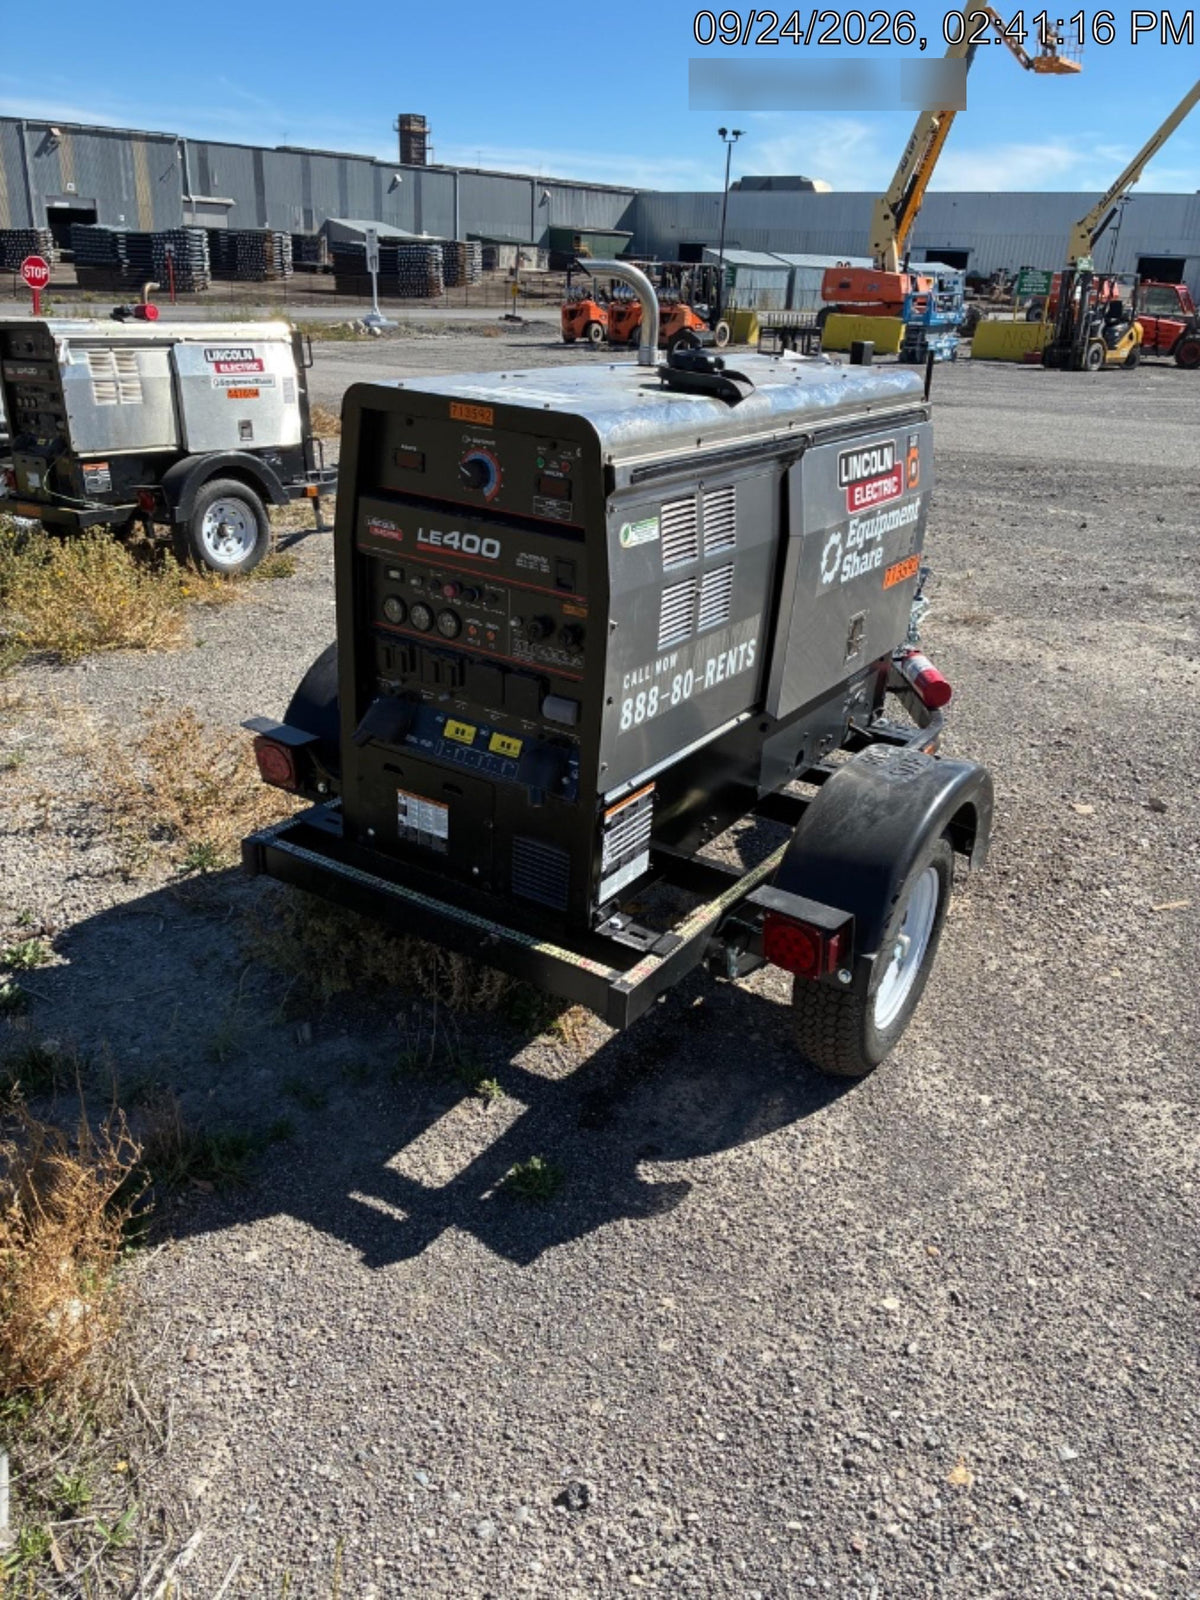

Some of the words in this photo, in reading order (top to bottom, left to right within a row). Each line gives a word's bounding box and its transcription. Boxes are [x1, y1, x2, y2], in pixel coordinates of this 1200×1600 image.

[24, 264, 49, 280] STOP
[206, 349, 253, 362] LINCOLN
[451, 405, 491, 423] 713592
[841, 446, 894, 482] LINCOLN
[854, 476, 898, 506] ELECTRIC
[846, 497, 921, 549] Equipment
[417, 527, 501, 559] LE400
[841, 546, 884, 583] Share
[620, 638, 757, 730] 888-80-RENTS
[623, 666, 650, 689] CALL
[655, 653, 678, 675] NOW
